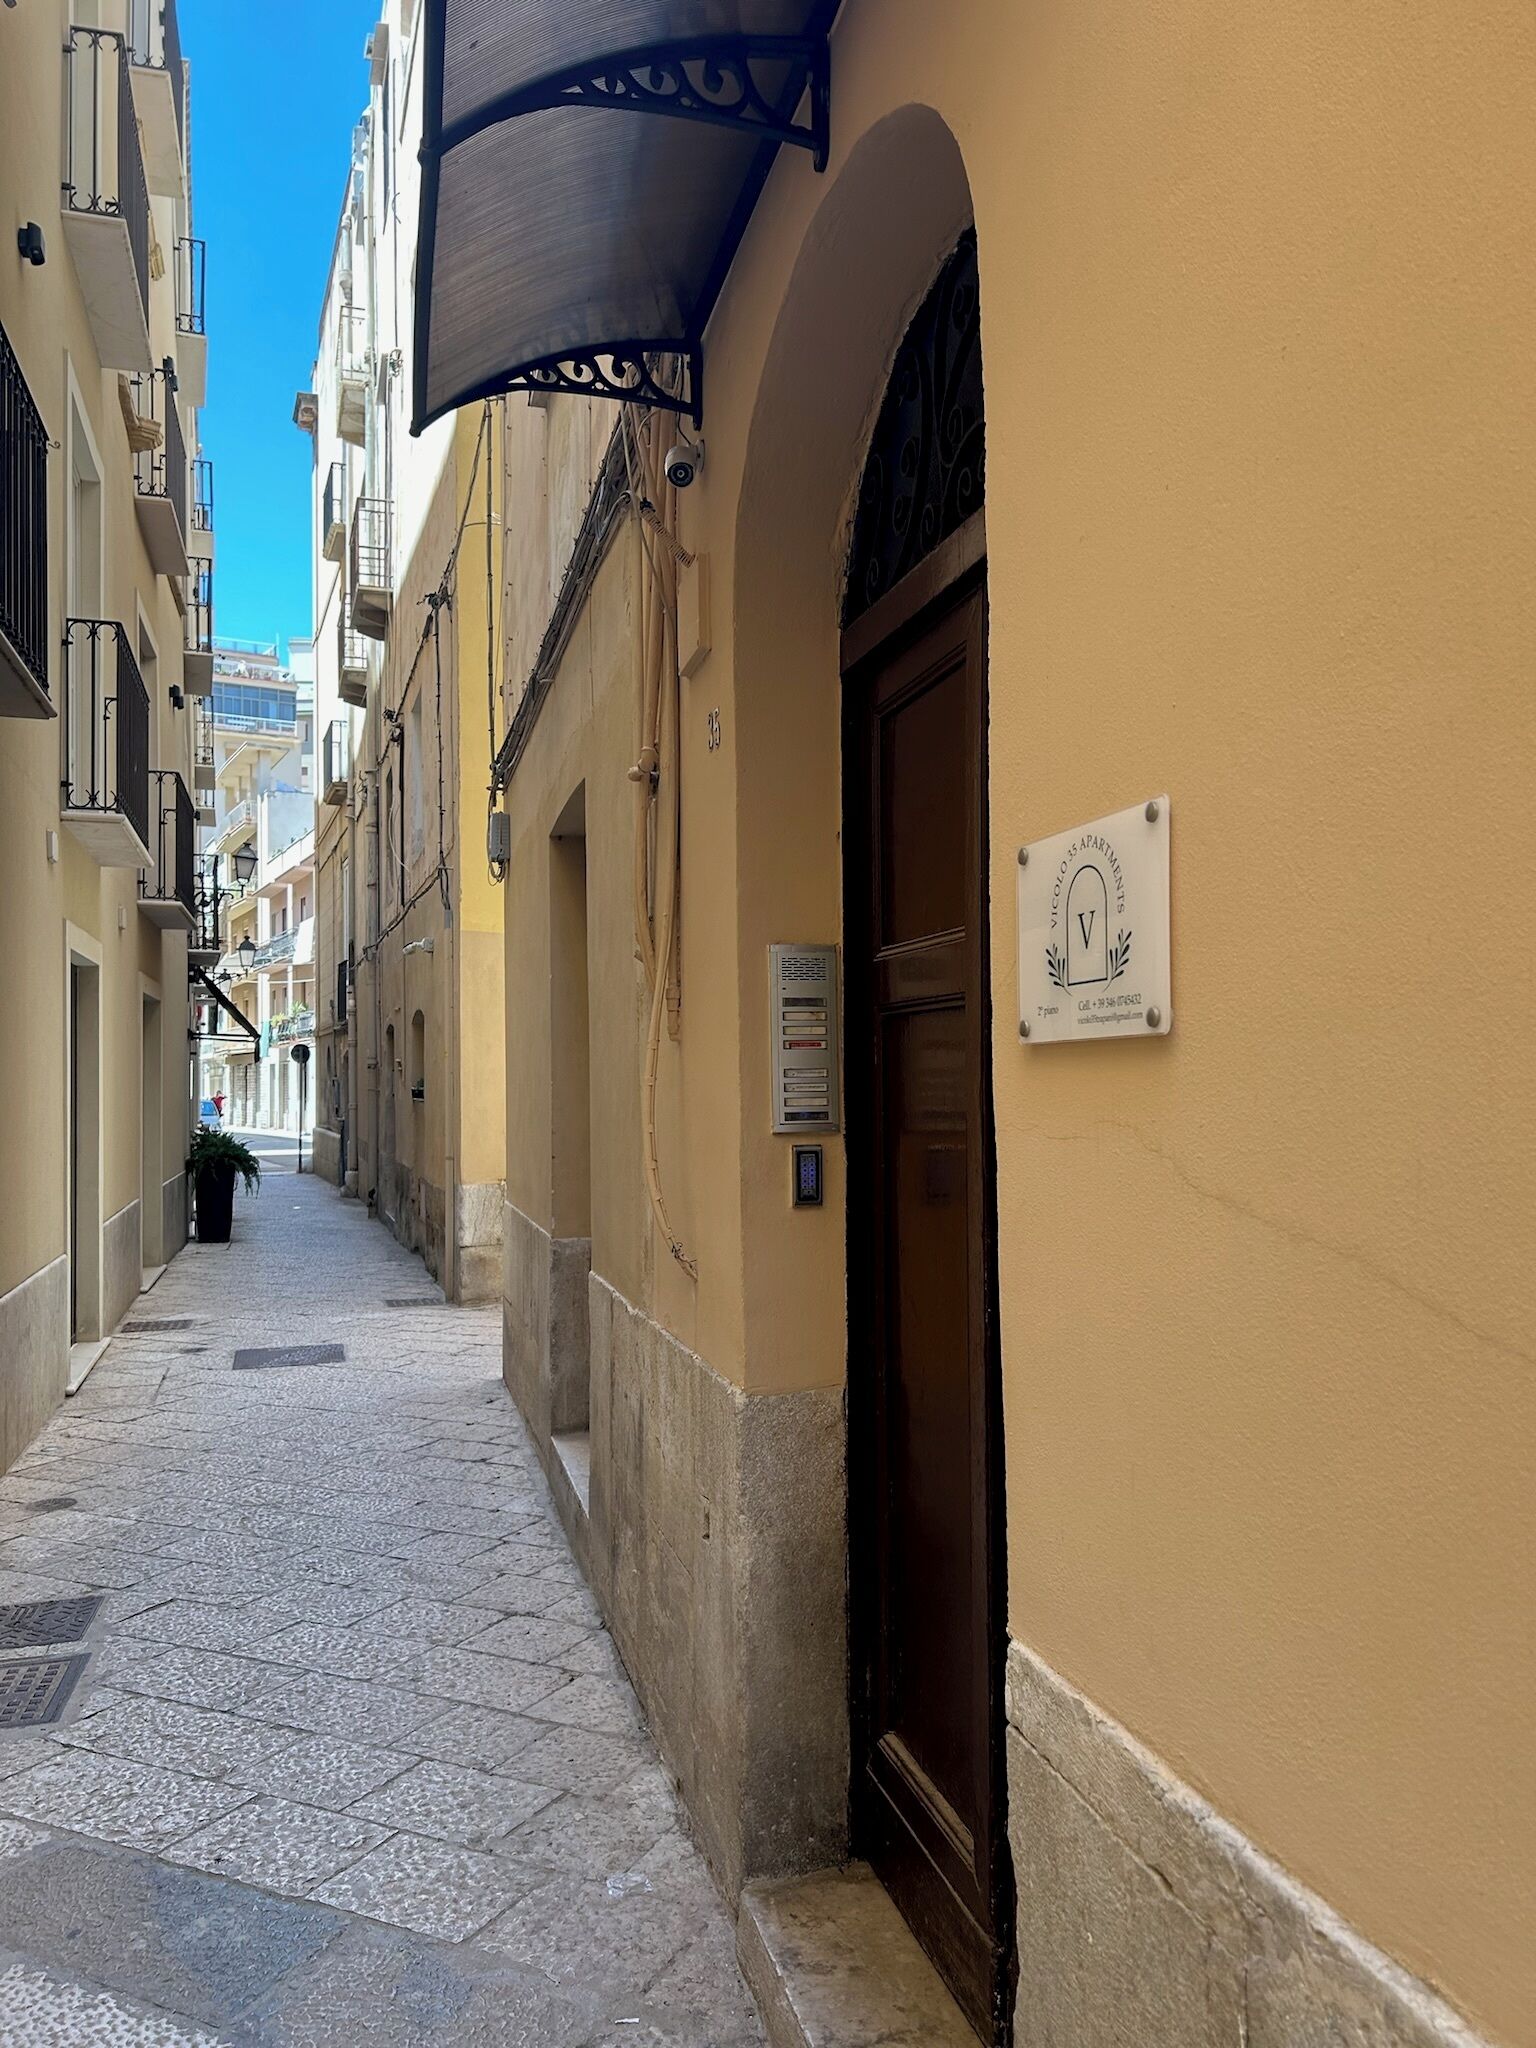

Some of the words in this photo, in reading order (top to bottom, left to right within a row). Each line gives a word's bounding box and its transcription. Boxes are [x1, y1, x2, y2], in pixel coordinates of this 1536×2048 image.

[708, 707, 721, 752] 35
[1050, 861, 1067, 928] VICOLO
[1067, 843, 1079, 863] 35
[1079, 835, 1125, 914] APARTMENTS
[1078, 910, 1096, 949] V
